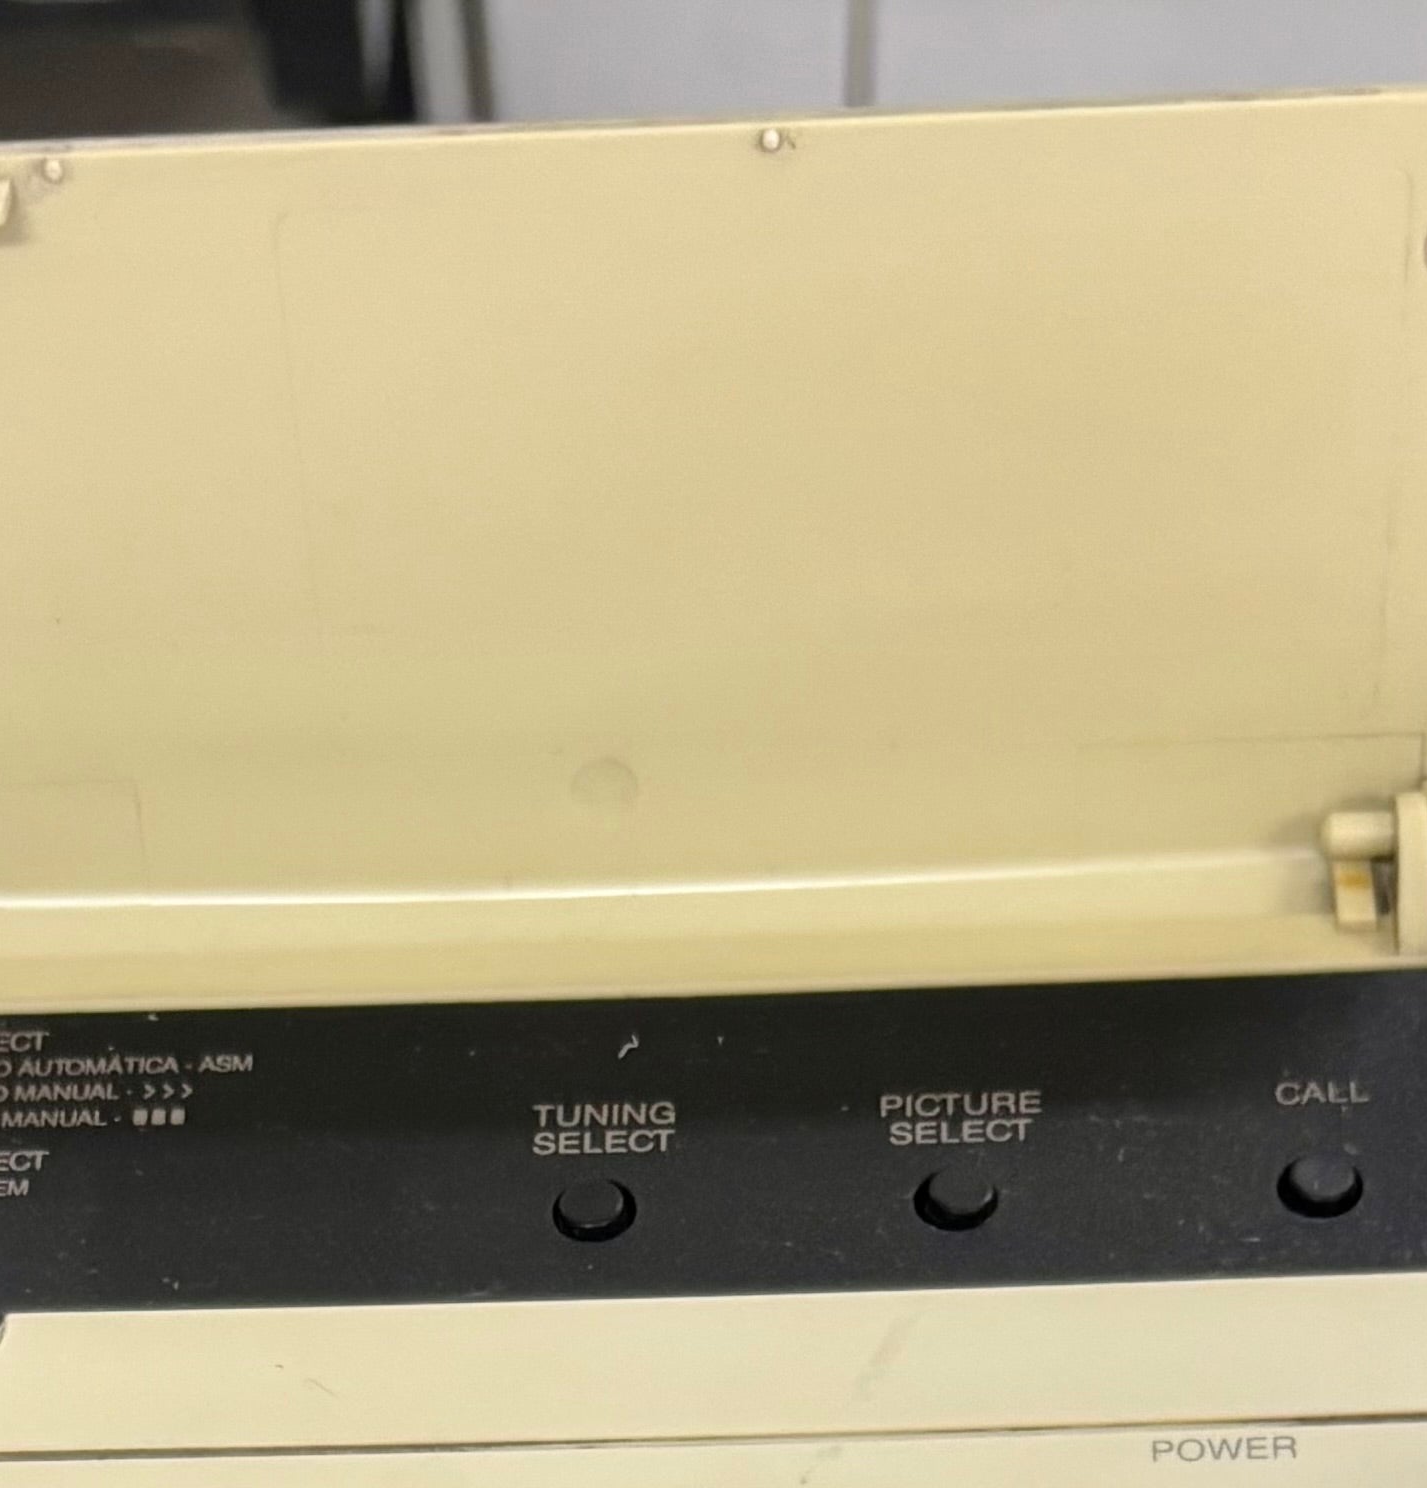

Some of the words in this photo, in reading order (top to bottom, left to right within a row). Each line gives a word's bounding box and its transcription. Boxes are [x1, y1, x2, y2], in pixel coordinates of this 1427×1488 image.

[198, 1054, 253, 1072] ASM
[14, 1083, 119, 1102] MANUAL
[879, 1090, 1043, 1117] PICTURE
[1274, 1081, 1370, 1105] CALL
[1, 1109, 108, 1129] MANUAL
[532, 1101, 676, 1128] TUNING
[532, 1129, 676, 1156] SELECT
[889, 1118, 1034, 1146] SELECT
[1151, 1435, 1297, 1462] POWER
